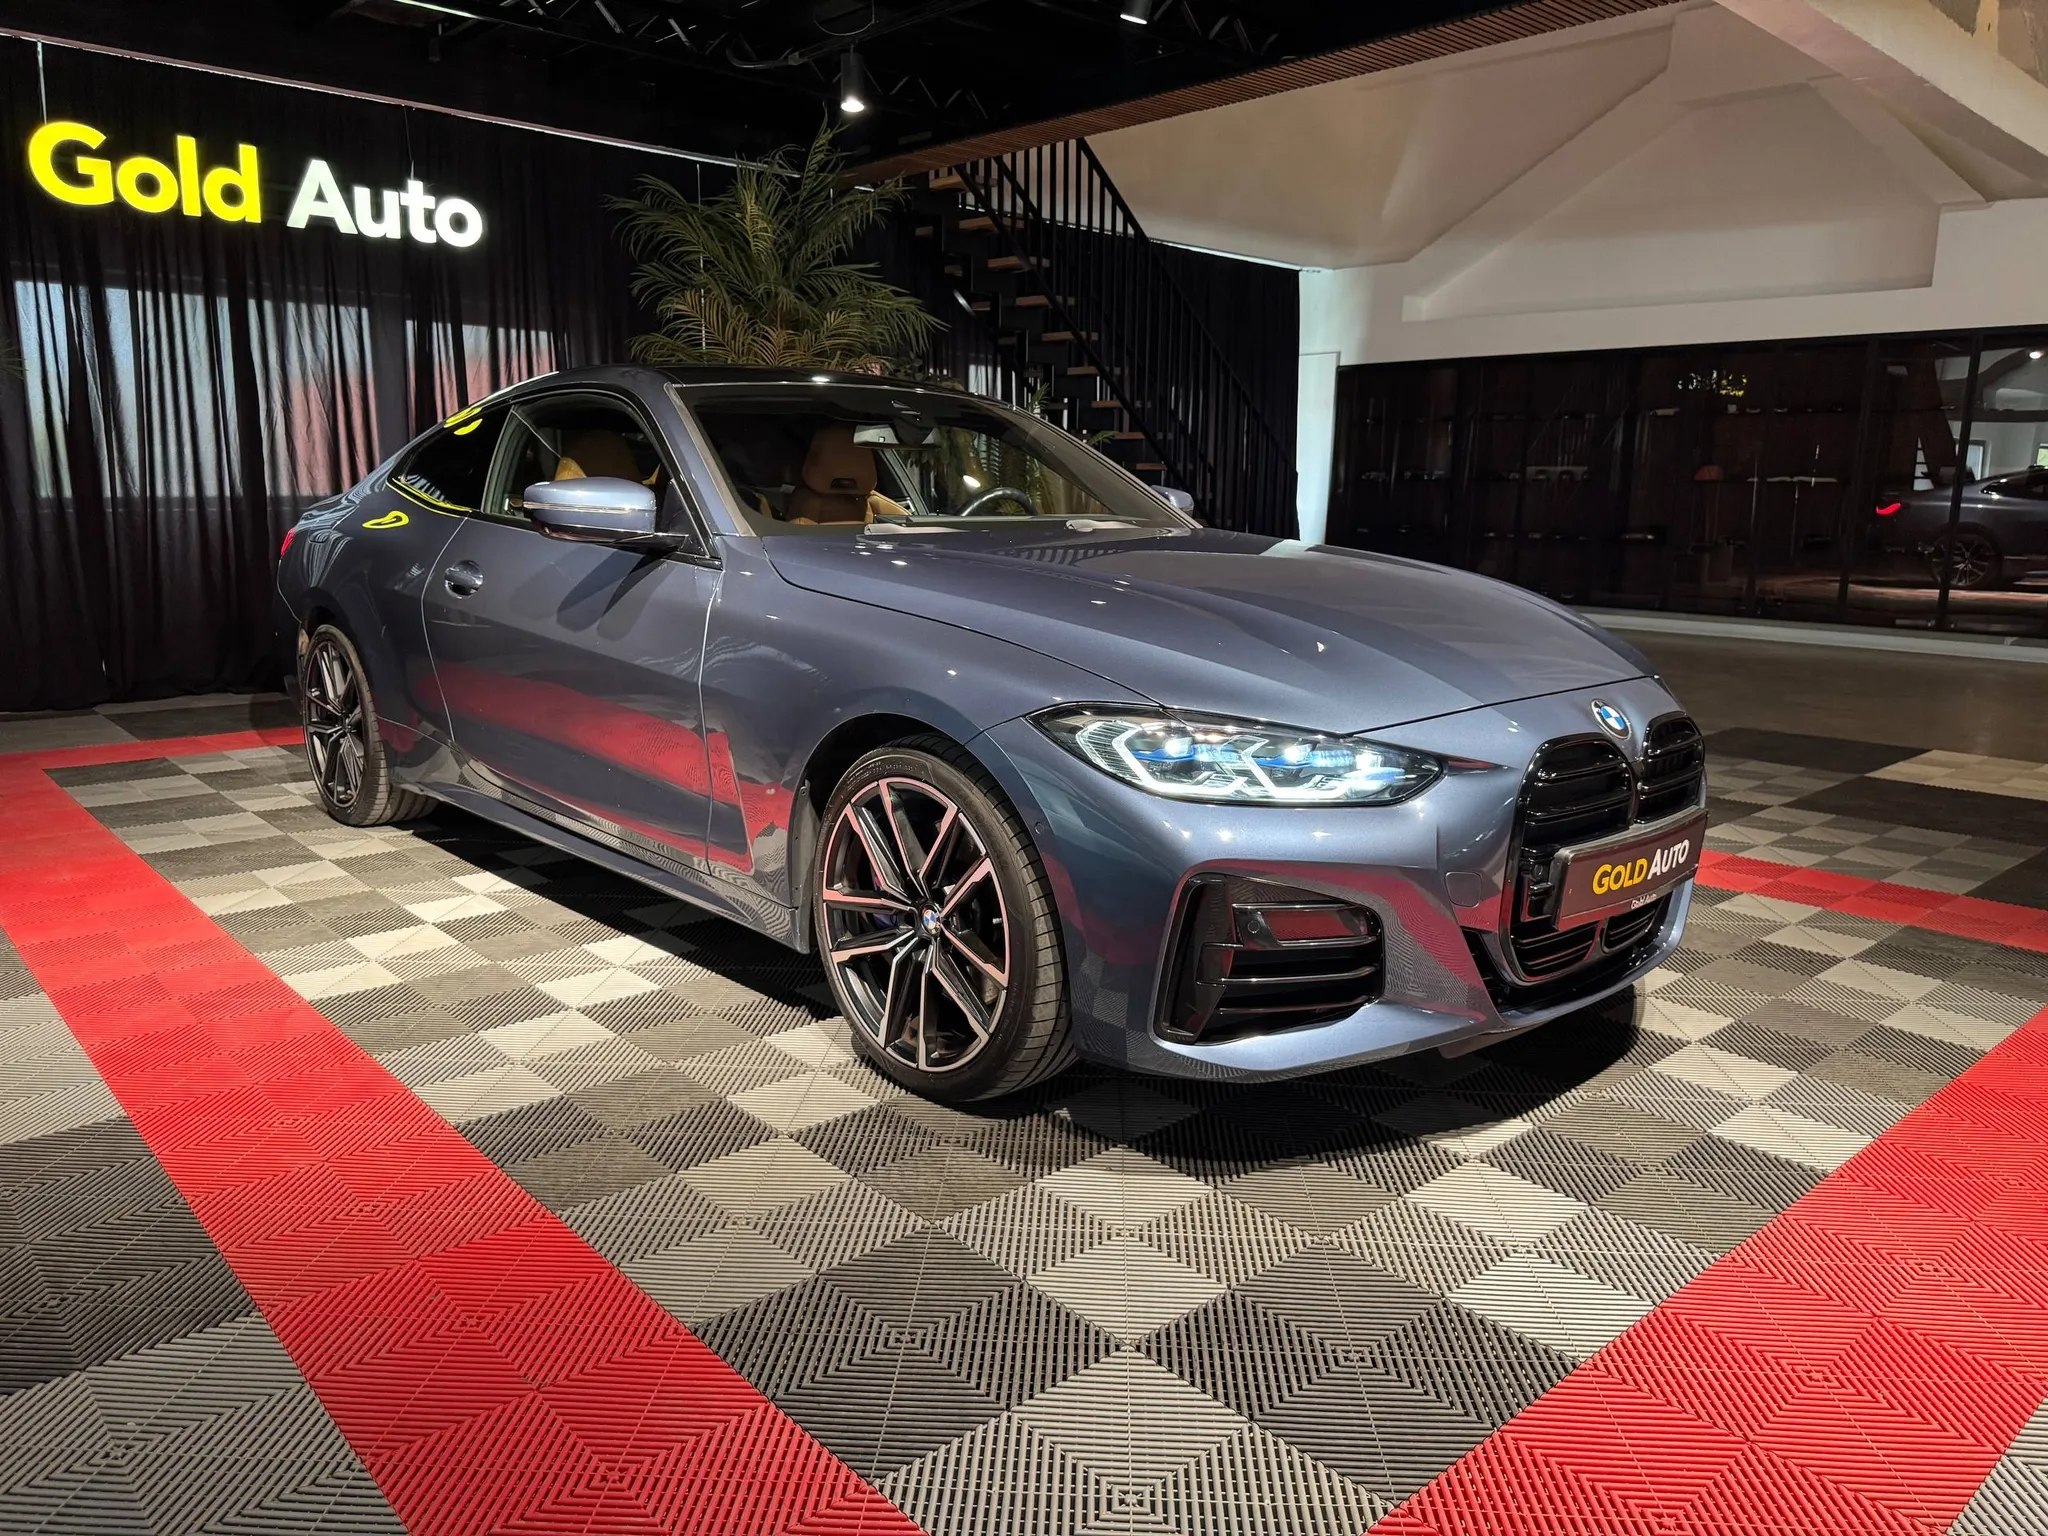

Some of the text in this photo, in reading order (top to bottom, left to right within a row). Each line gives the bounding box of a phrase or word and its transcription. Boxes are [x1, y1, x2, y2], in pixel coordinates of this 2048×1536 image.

[27, 120, 484, 248] Gold Auto
[1592, 839, 1690, 895] GOLD AUTO
